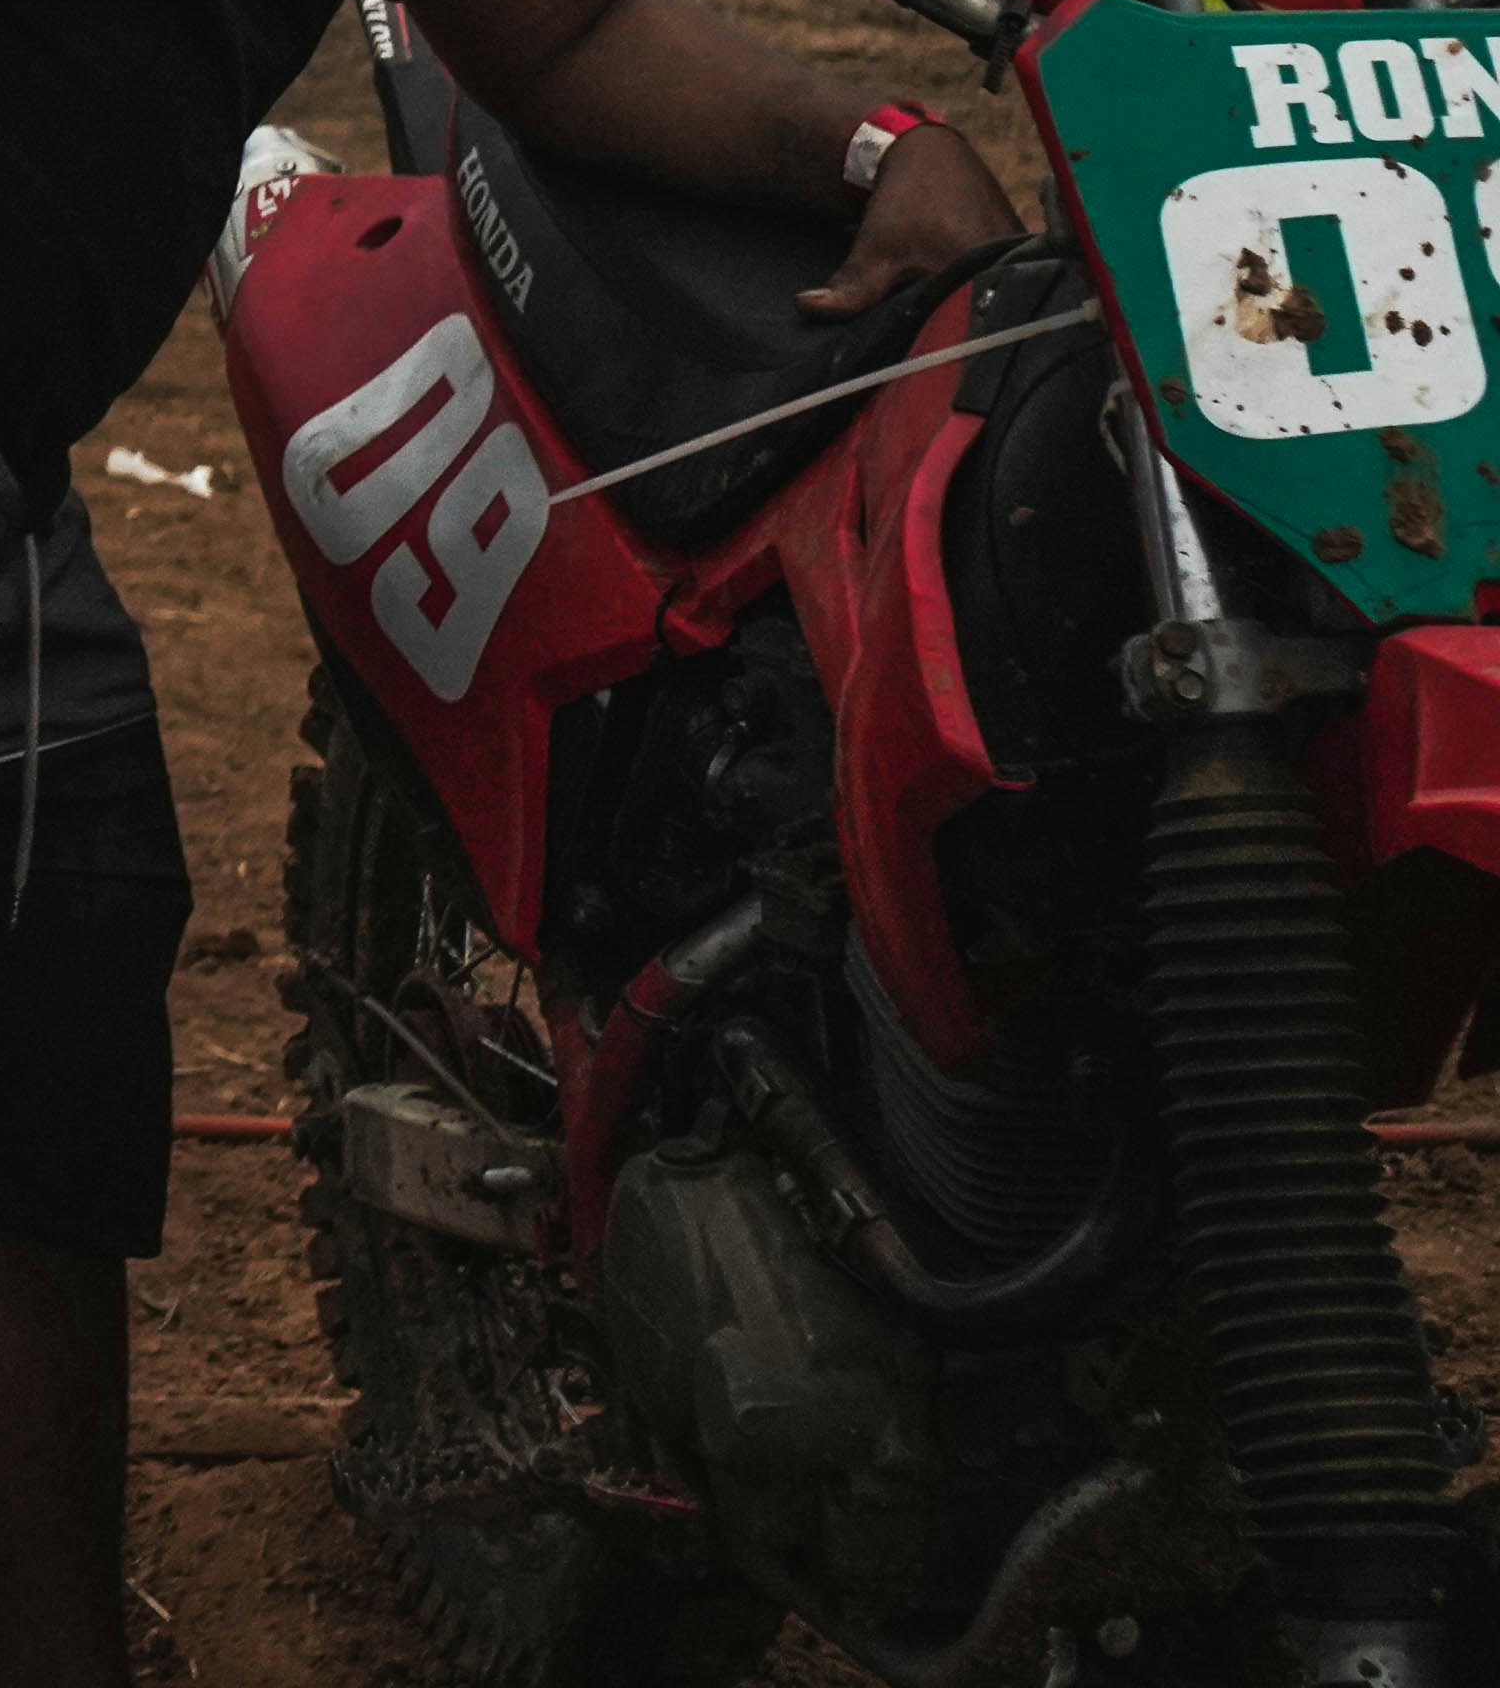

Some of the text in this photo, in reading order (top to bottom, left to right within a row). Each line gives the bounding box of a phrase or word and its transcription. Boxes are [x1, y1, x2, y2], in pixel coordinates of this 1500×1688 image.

[458, 146, 534, 313] HONDA
[1160, 157, 1500, 440] 0
[282, 312, 550, 703] 09
